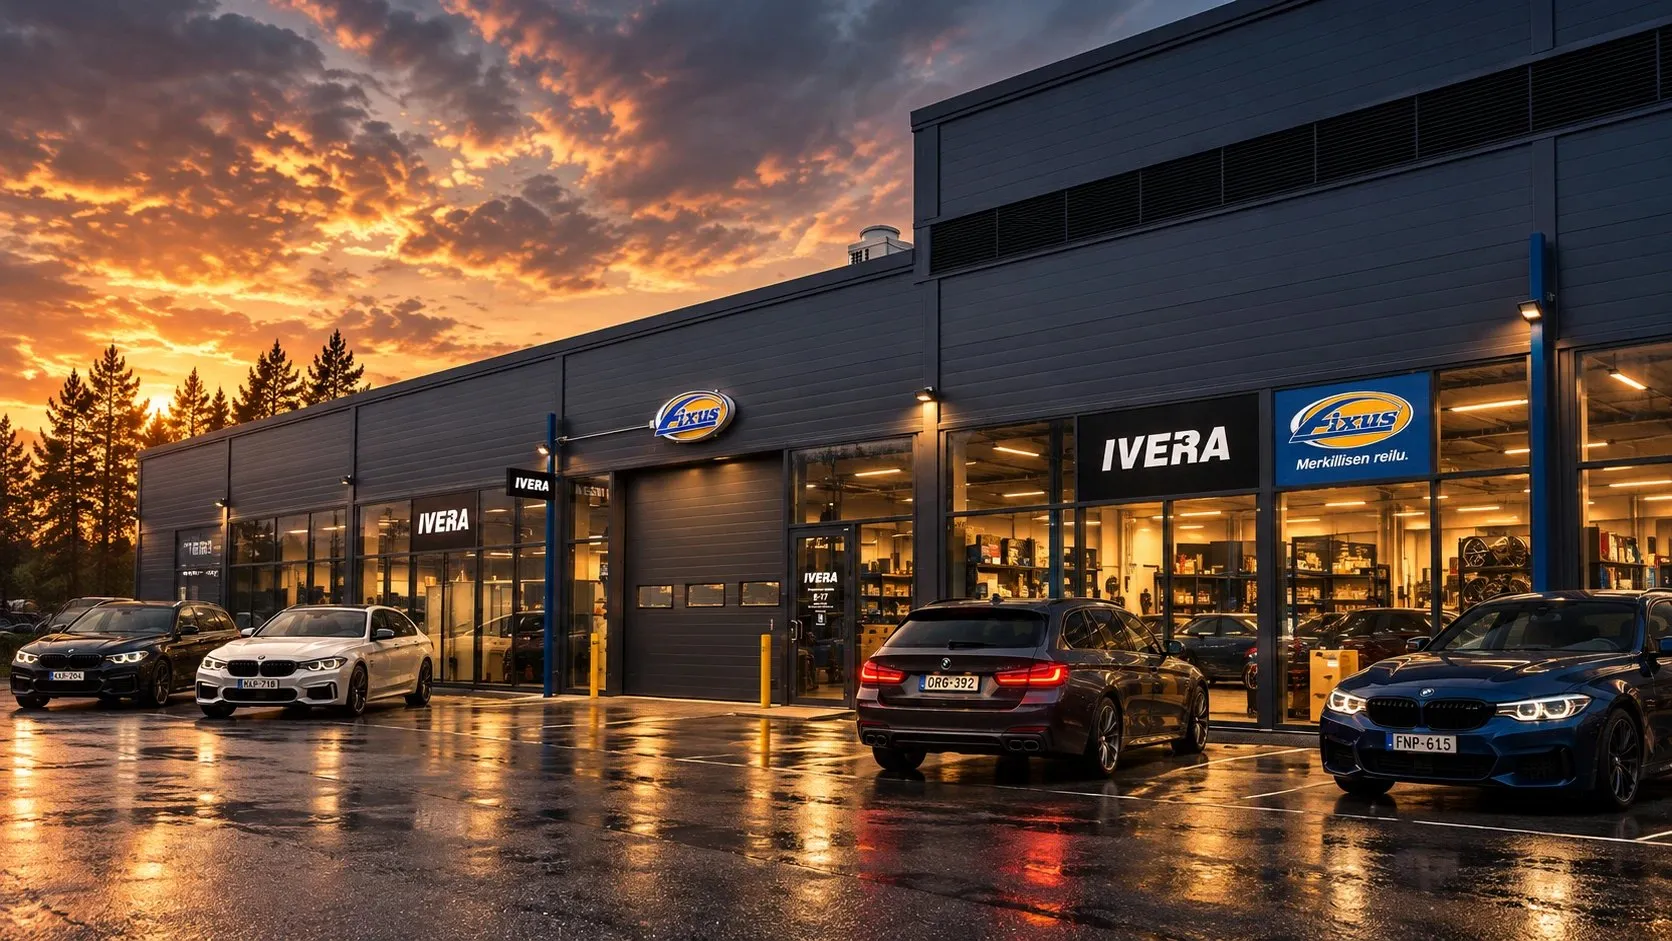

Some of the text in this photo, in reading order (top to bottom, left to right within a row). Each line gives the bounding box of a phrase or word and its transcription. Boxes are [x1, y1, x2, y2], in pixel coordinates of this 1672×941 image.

[655, 394, 722, 437] Fixus
[1288, 397, 1403, 444] Fixus
[1101, 425, 1231, 472] IVERA
[1296, 448, 1409, 471] Merkillisen reilu.
[514, 476, 550, 492] IVERA
[418, 507, 470, 535] IVERA
[803, 571, 838, 584] IVERA
[927, 676, 975, 689] ORG-392
[1396, 735, 1452, 752] FNP-615
